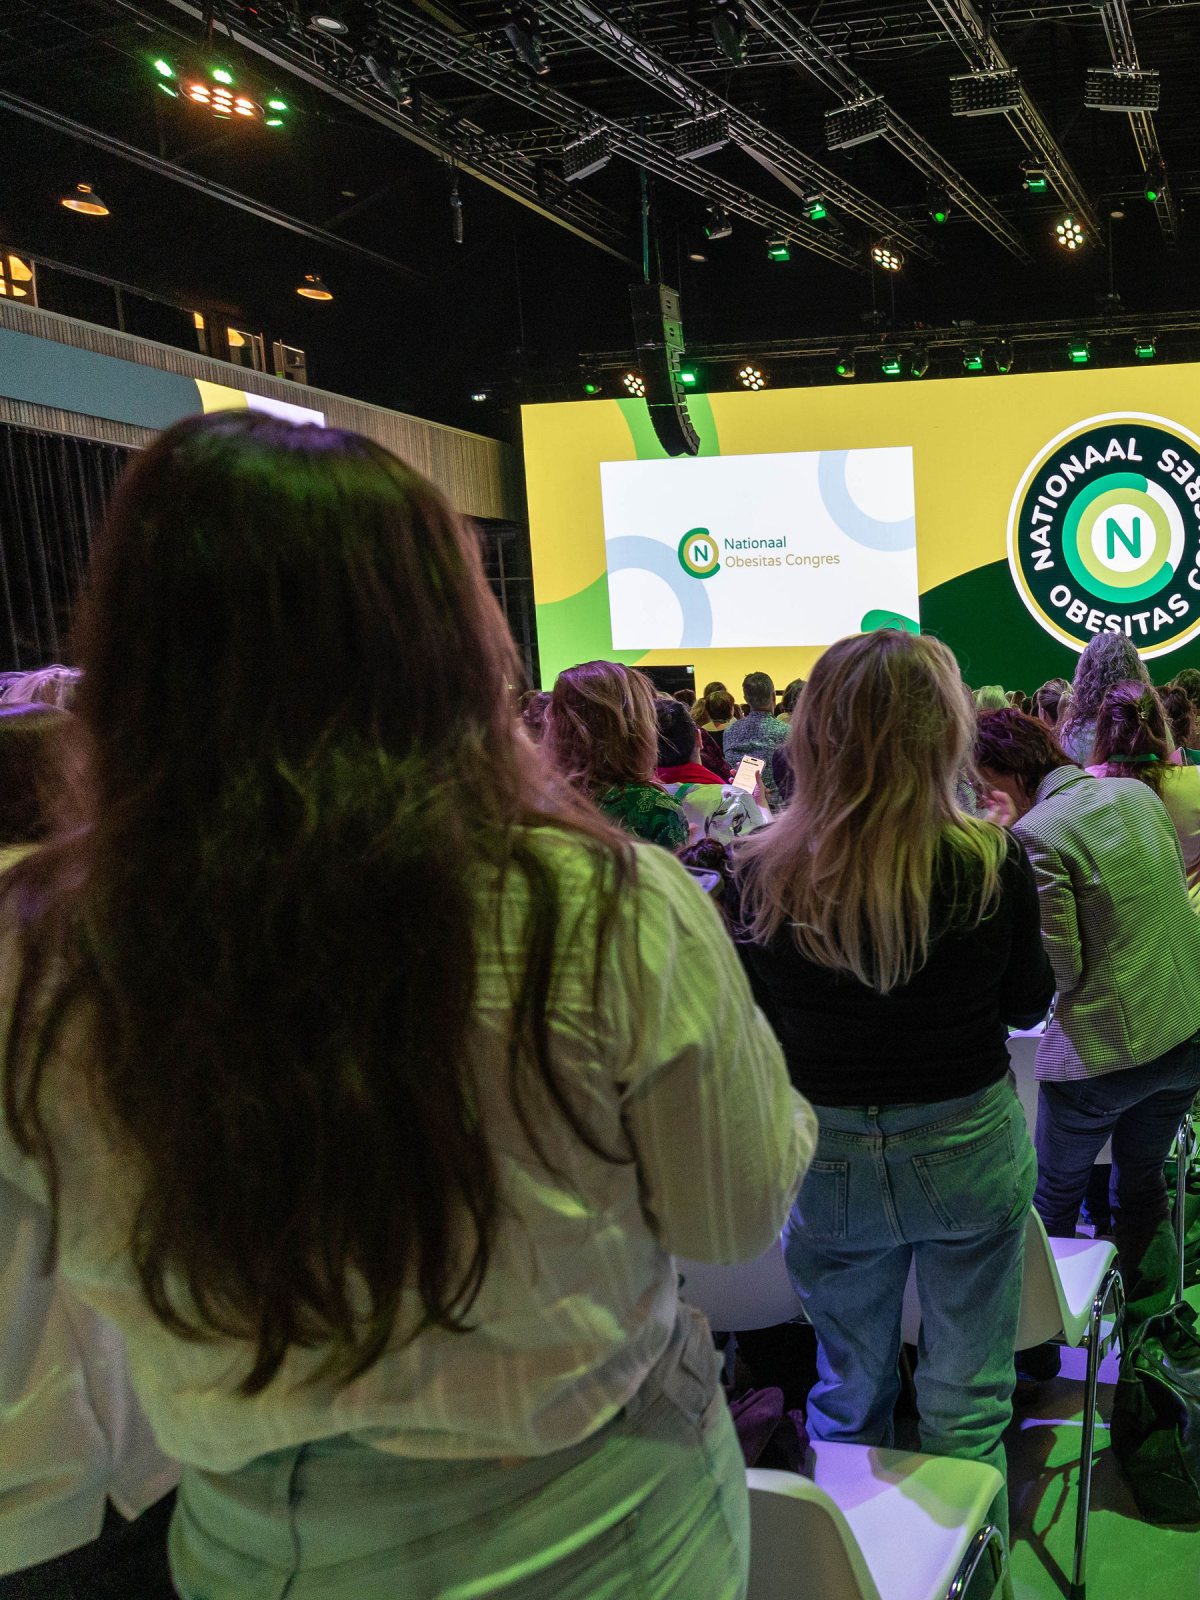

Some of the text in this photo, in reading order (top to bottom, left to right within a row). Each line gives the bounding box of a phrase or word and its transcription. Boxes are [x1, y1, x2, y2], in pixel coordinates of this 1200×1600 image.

[1030, 437, 1142, 571] NATIONAAL
[694, 544, 708, 562] N
[724, 536, 787, 550] Nationaal
[1106, 516, 1141, 560] N
[725, 553, 841, 569] Obesitas Congres
[1050, 585, 1189, 637] OBESITAS
